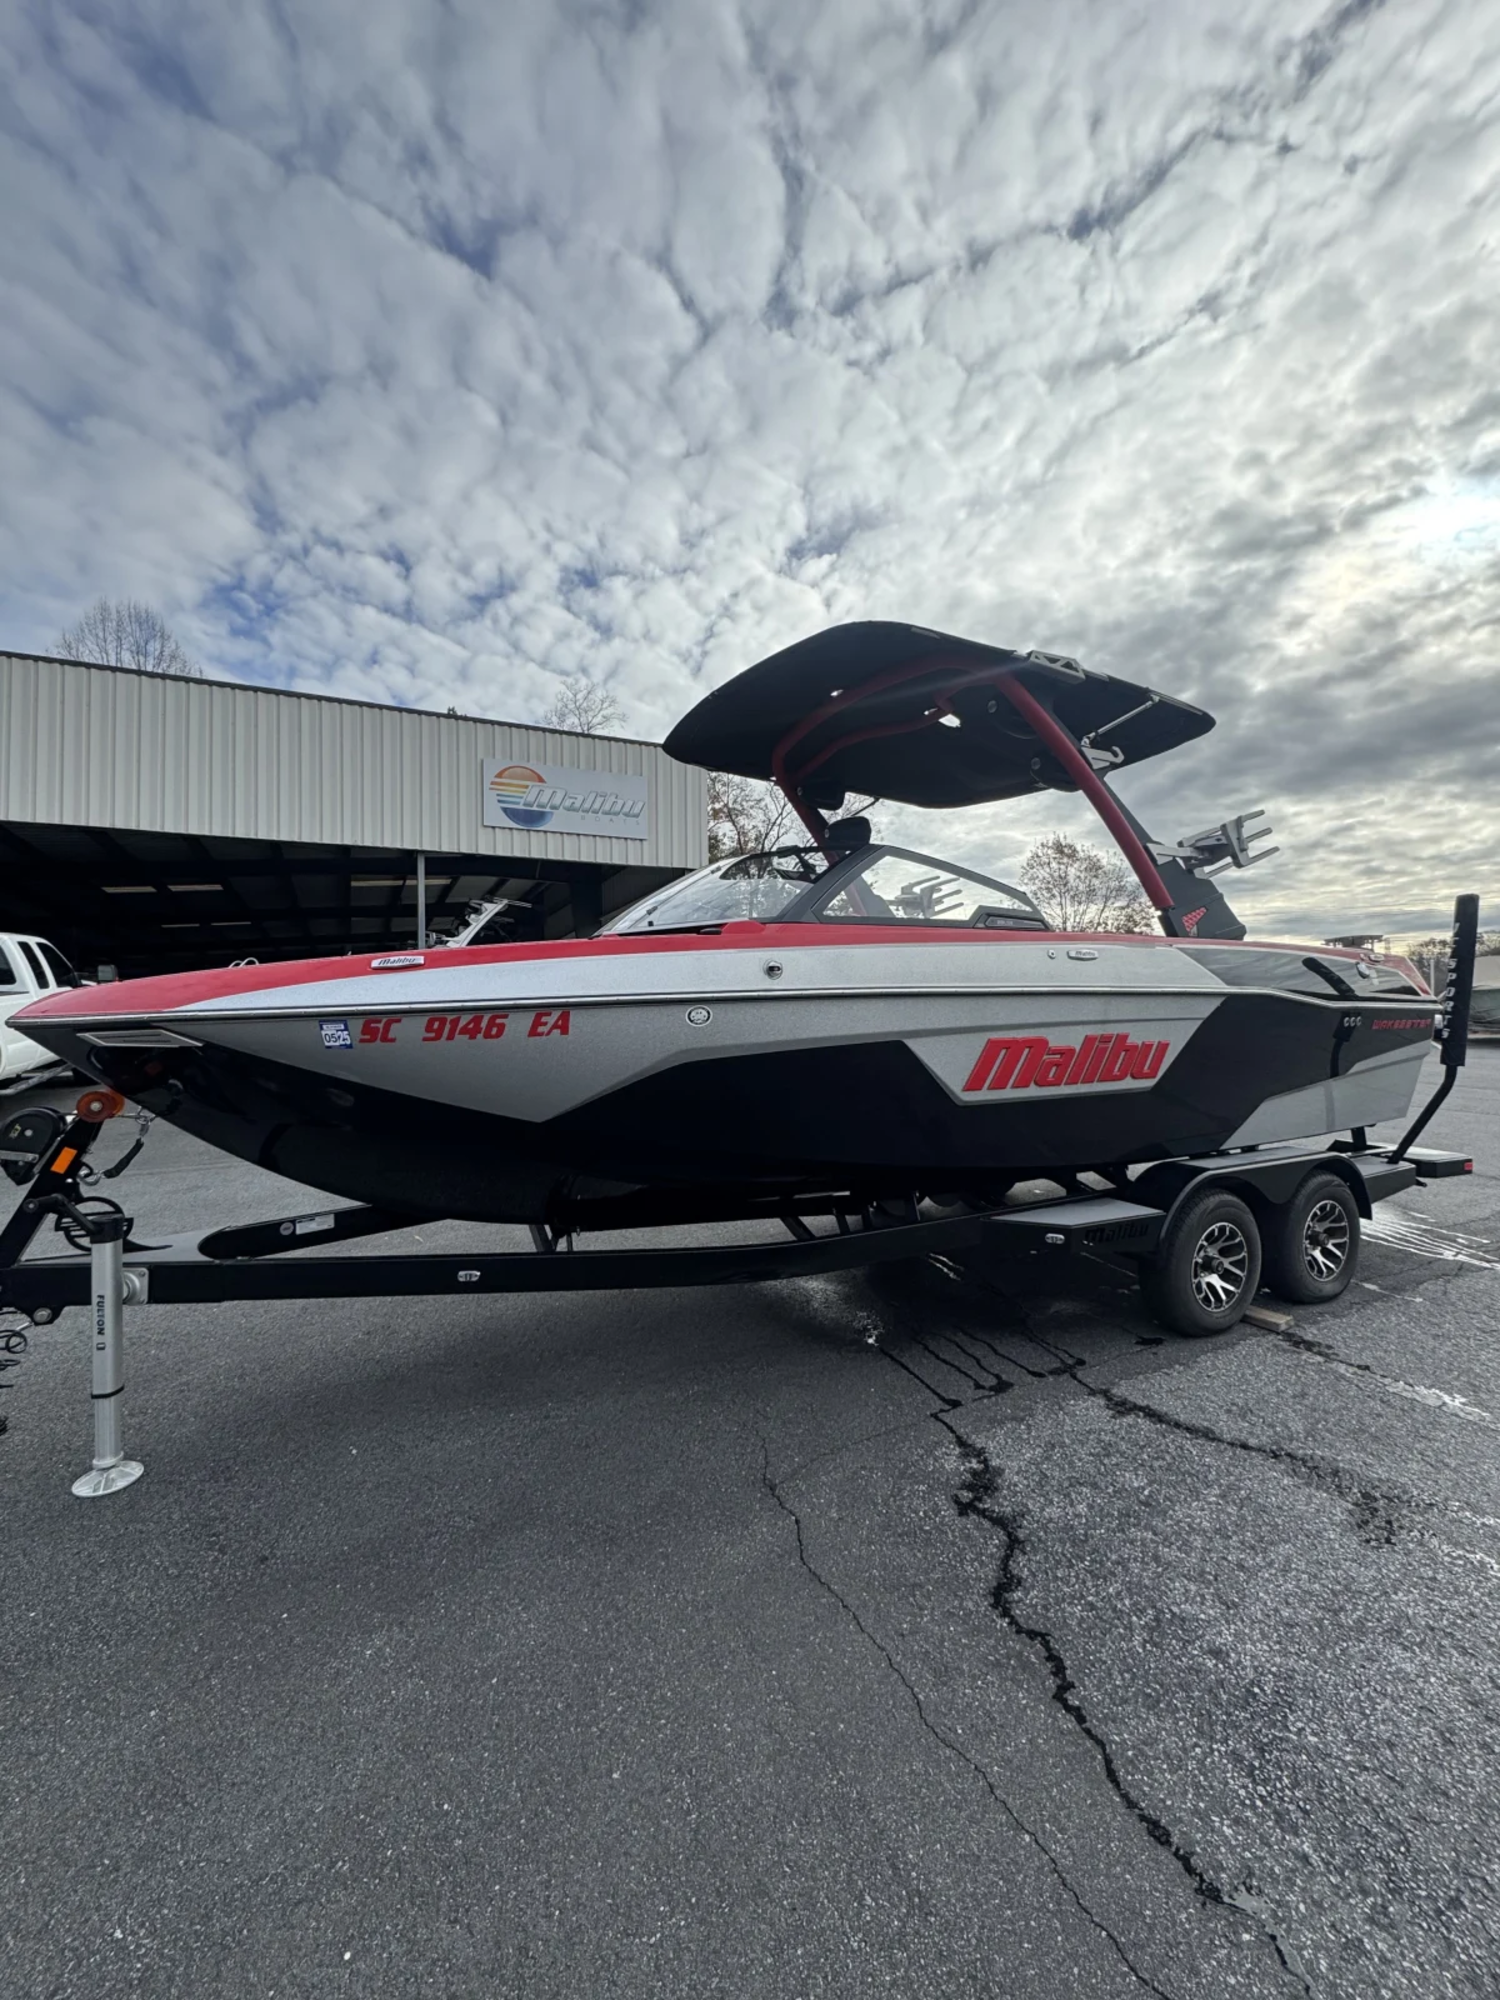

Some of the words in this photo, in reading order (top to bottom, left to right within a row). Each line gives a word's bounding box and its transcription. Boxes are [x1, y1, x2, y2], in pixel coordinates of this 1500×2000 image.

[522, 785, 645, 818] Malibu
[580, 815, 640, 825] BOATS
[378, 956, 416, 966] Malibu
[358, 1017, 402, 1043] SC
[422, 1013, 509, 1042] 9146
[527, 1010, 571, 1038] EA
[962, 1033, 1170, 1092] Malibu
[96, 1294, 105, 1336] FULTON
